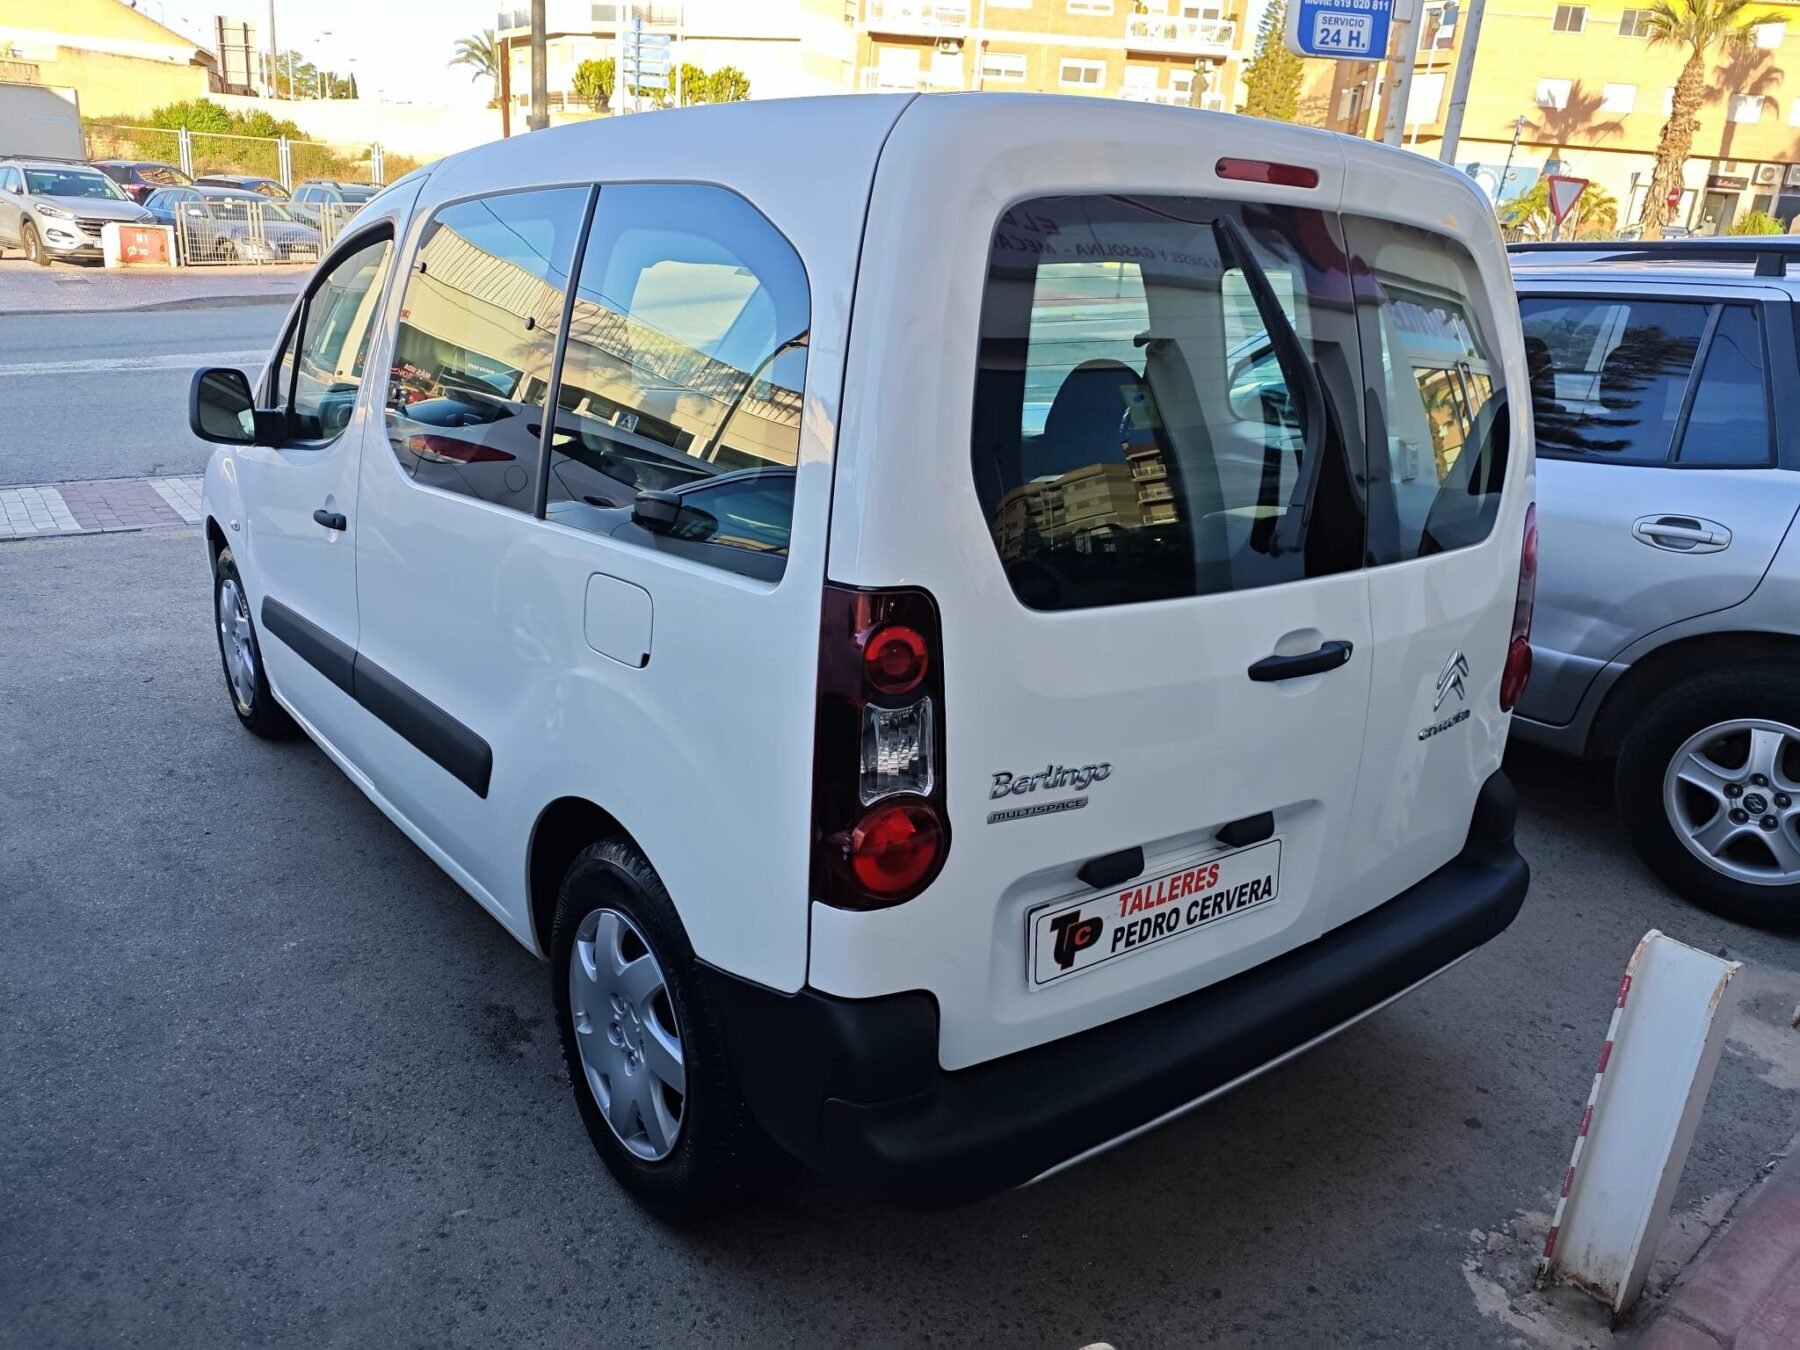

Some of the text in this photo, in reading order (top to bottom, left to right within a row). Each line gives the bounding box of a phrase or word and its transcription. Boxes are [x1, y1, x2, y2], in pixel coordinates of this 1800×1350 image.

[1334, 0, 1351, 8] 619
[1353, 0, 1370, 9] 020
[1372, 0, 1389, 11] 811
[1321, 16, 1365, 28] SERVICIO
[1319, 28, 1366, 48] 24 H.
[989, 762, 1112, 800] Berlingo
[992, 799, 1084, 821] MULTISPACE
[1118, 863, 1220, 918] TALLERES
[1110, 875, 1273, 953] PEDRO CERVERA
